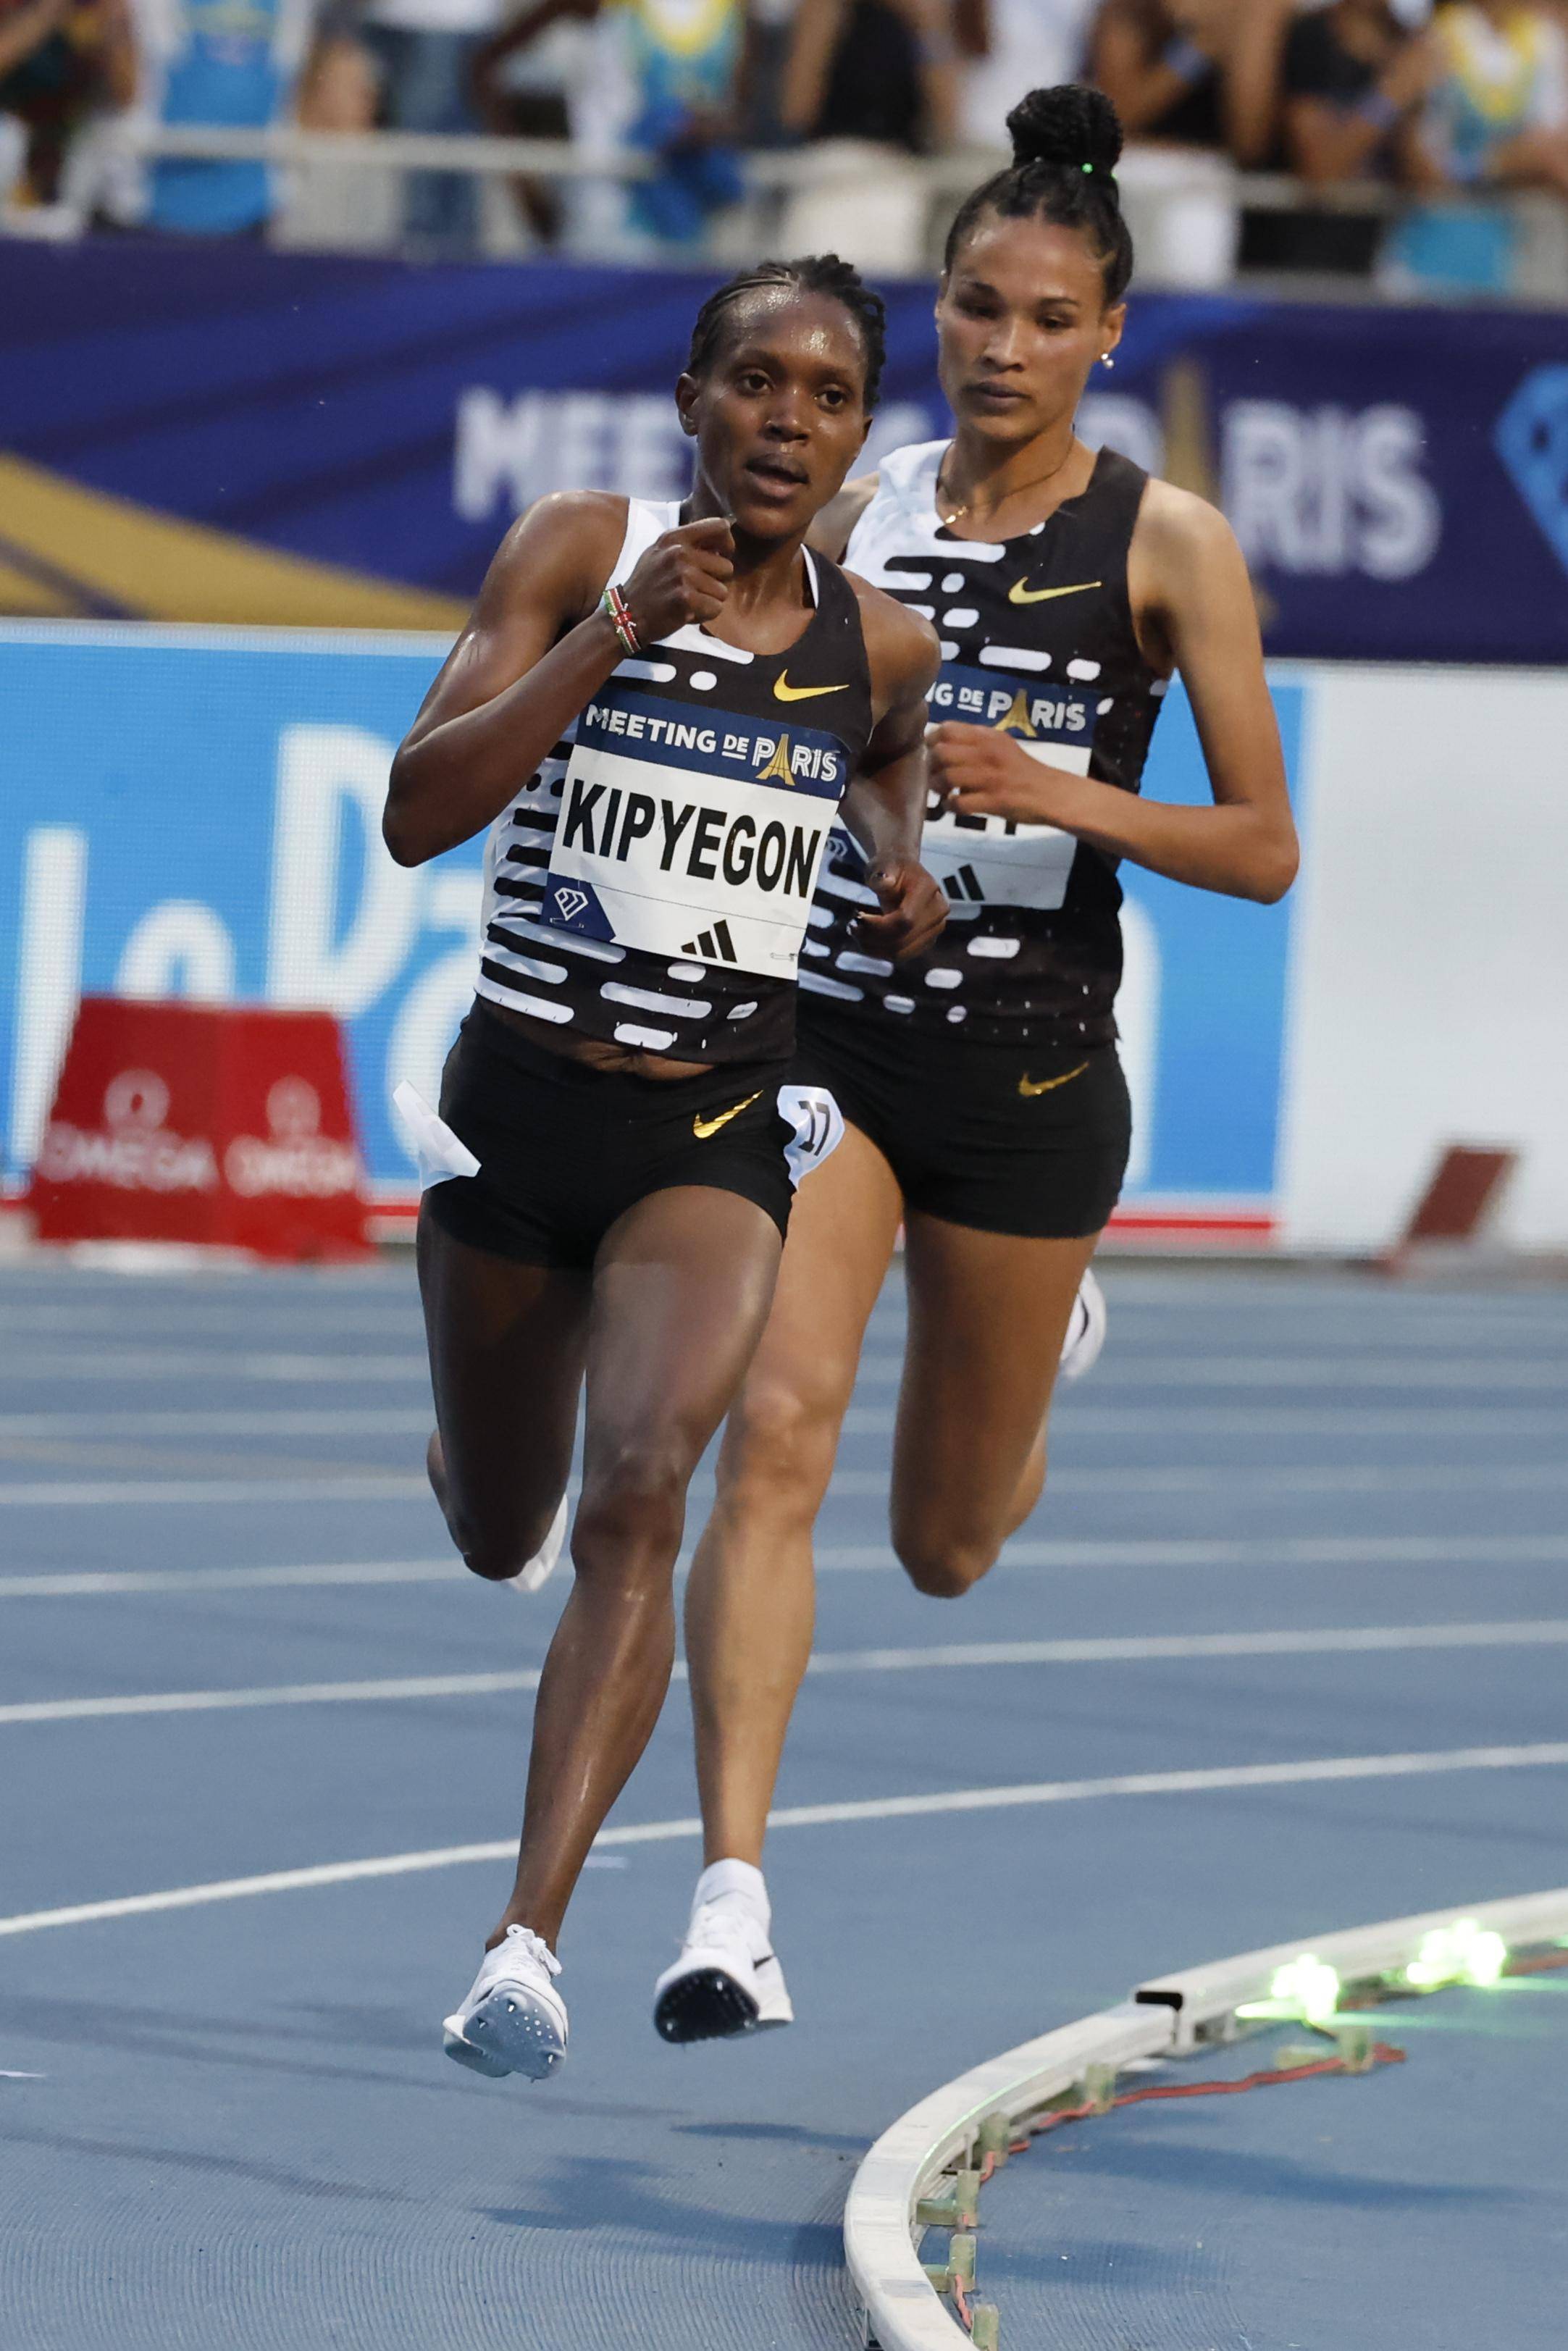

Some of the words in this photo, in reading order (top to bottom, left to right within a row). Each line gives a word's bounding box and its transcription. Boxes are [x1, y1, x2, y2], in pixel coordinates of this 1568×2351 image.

[958, 687, 984, 713] DE
[586, 704, 716, 753] MEETING
[722, 734, 750, 760] DE
[752, 733, 838, 787] PARIS
[562, 779, 821, 898] KIPYEGON
